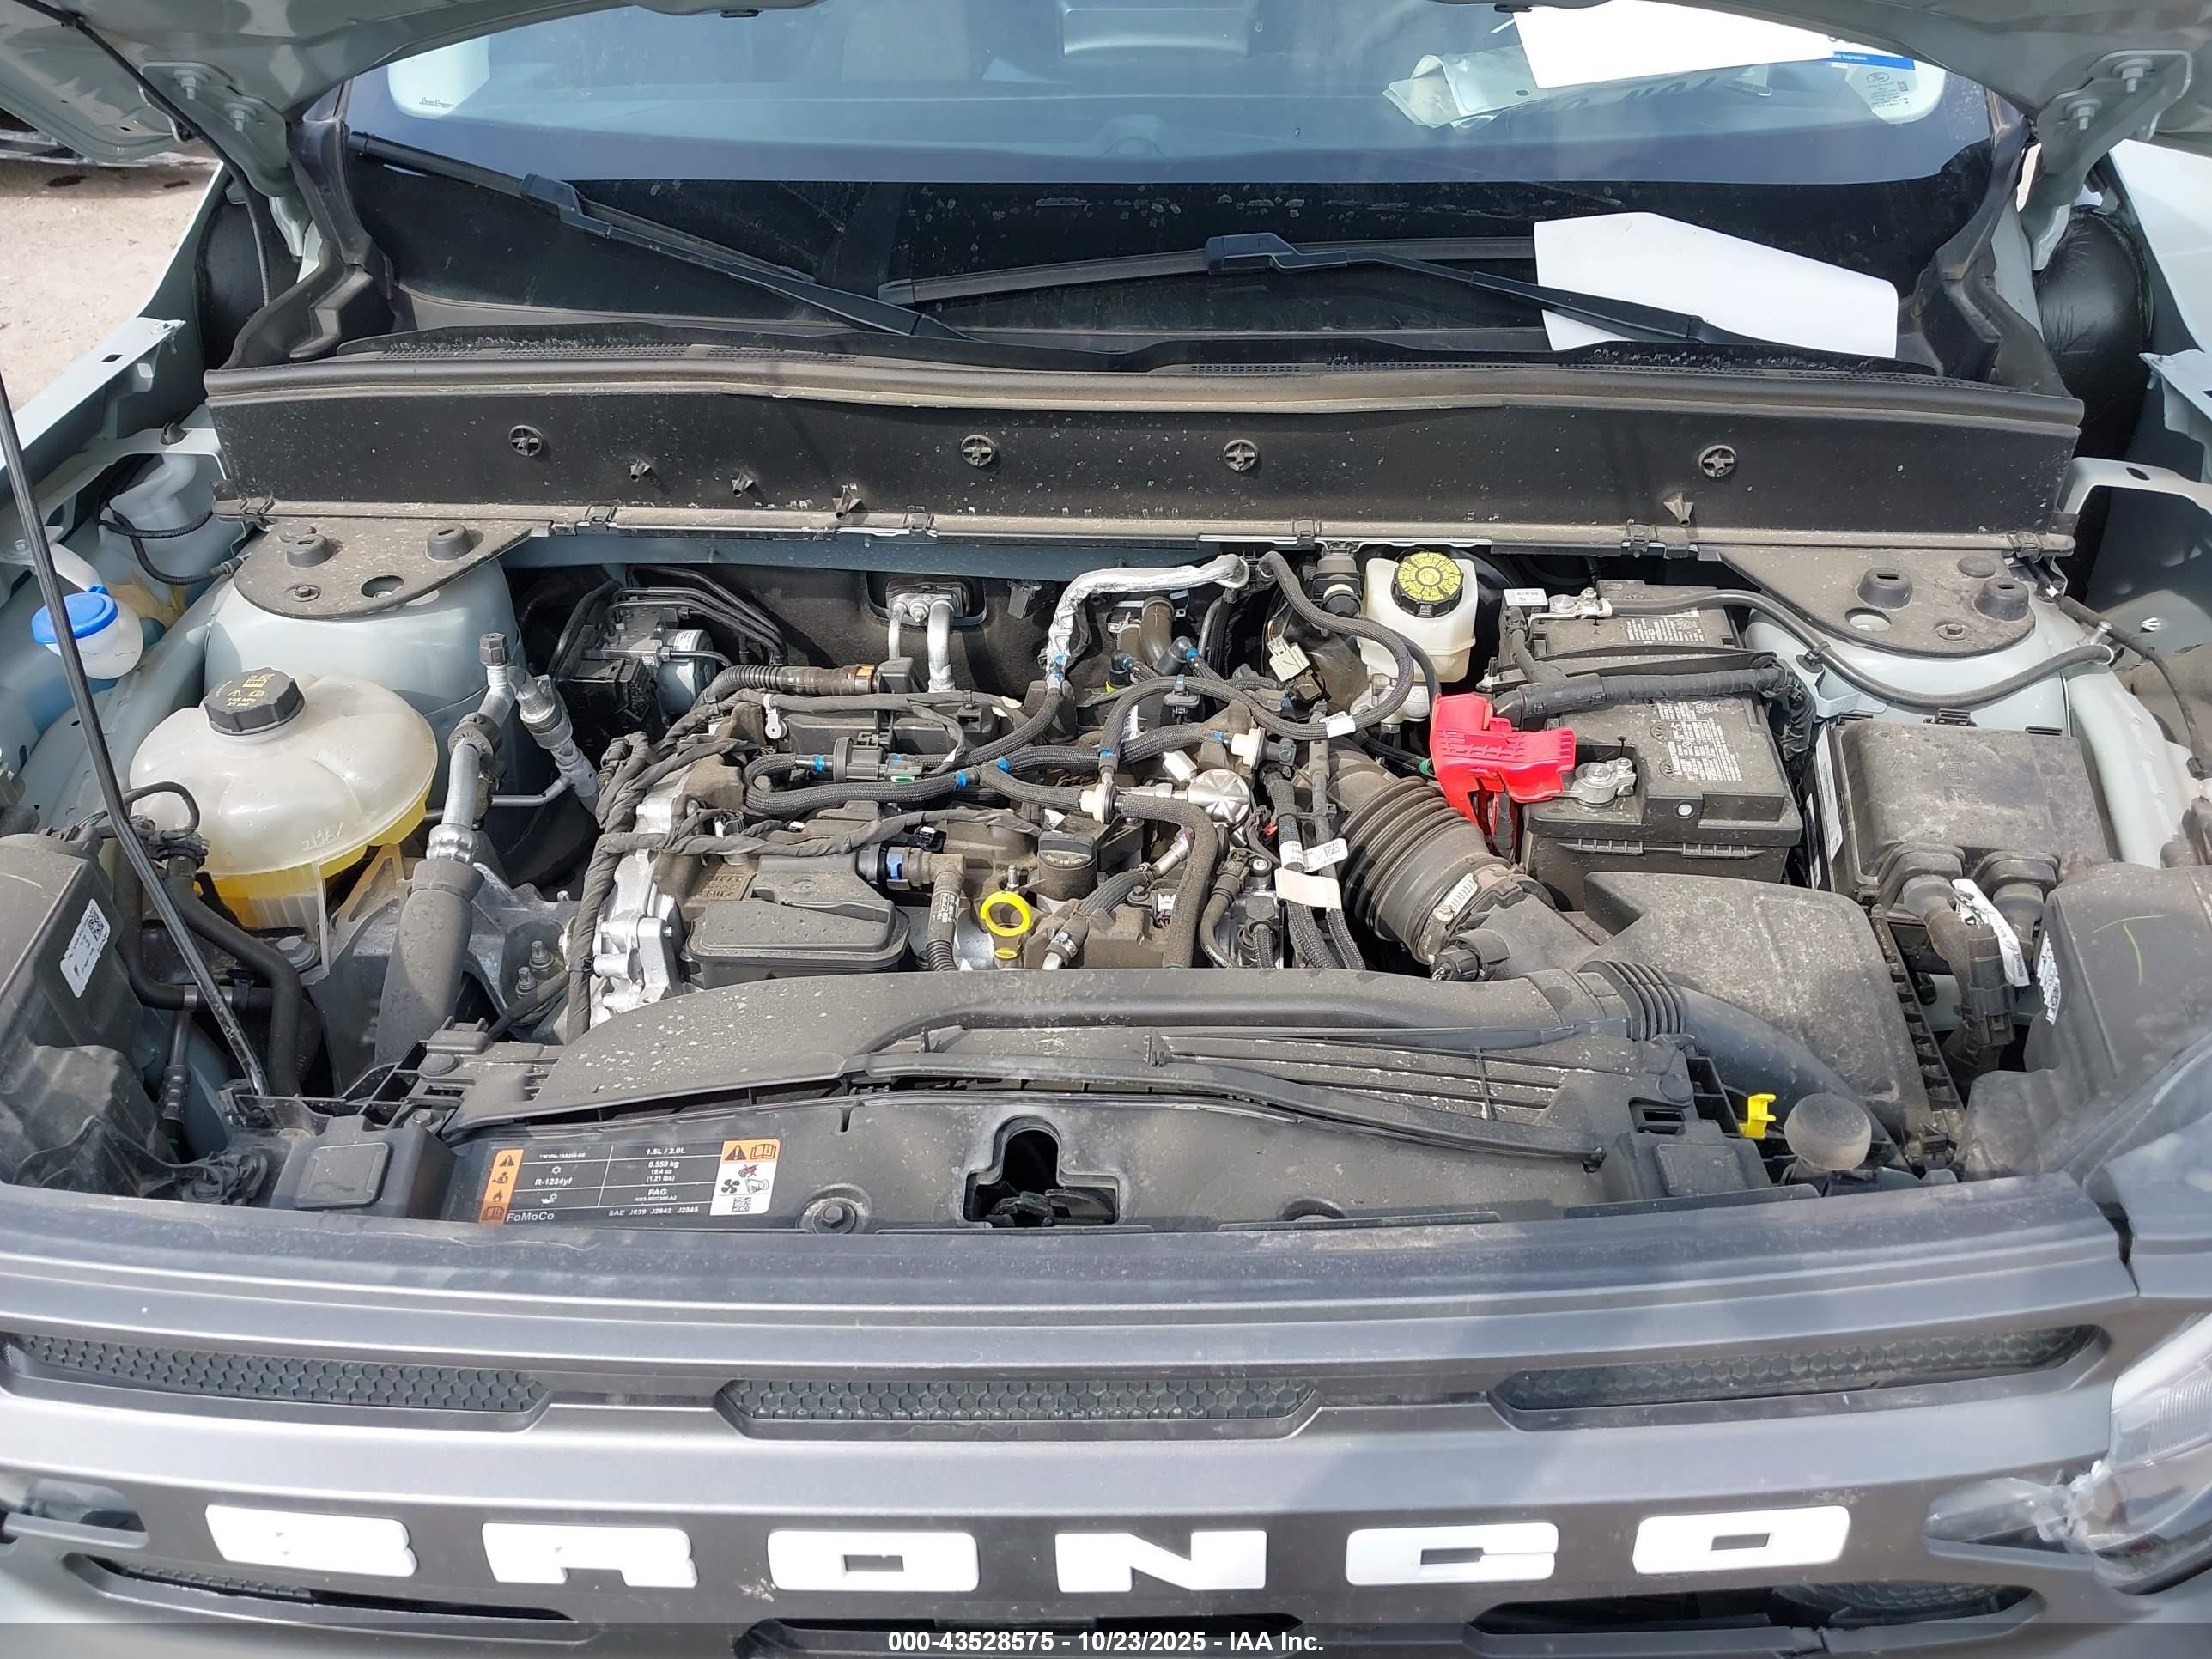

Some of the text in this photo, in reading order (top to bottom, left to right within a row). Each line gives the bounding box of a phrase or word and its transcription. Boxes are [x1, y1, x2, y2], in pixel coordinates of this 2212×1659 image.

[534, 1177, 573, 1186] R-1234yf
[507, 1212, 555, 1221] FoMoCo
[204, 1504, 1850, 1594] BRONCO
